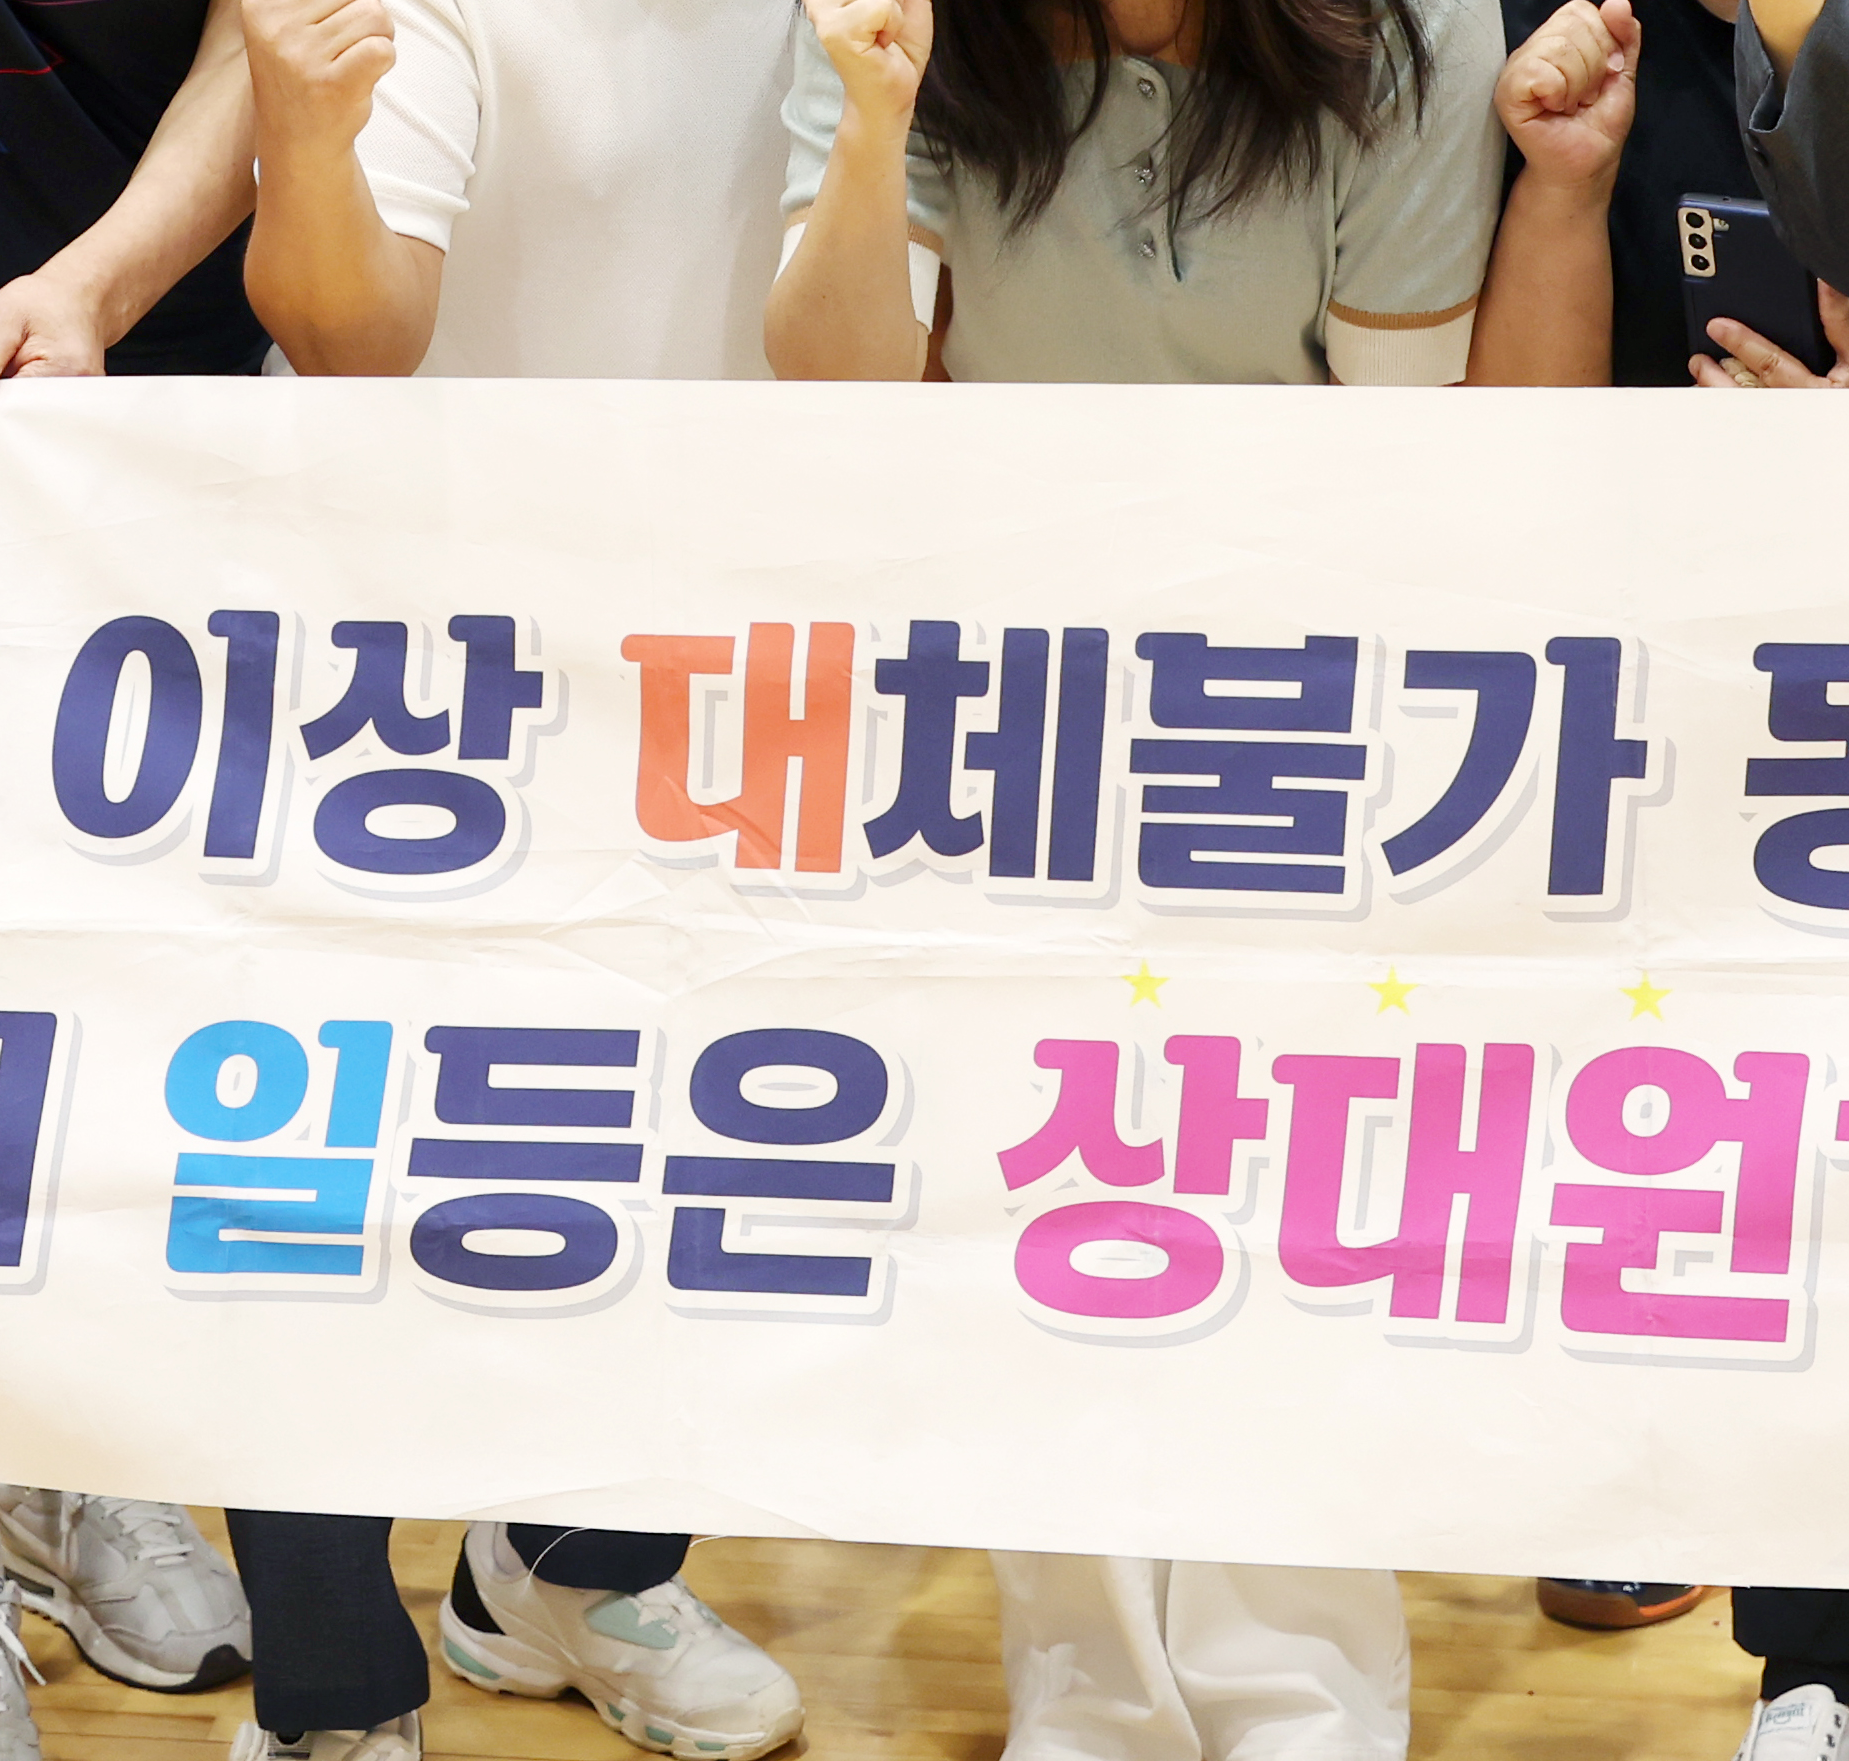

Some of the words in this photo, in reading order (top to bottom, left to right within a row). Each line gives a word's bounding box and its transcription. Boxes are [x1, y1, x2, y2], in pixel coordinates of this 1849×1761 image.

[50, 608, 544, 876] 이상
[620, 616, 1647, 898] 대체불가
[163, 1018, 896, 1293] 일등은
